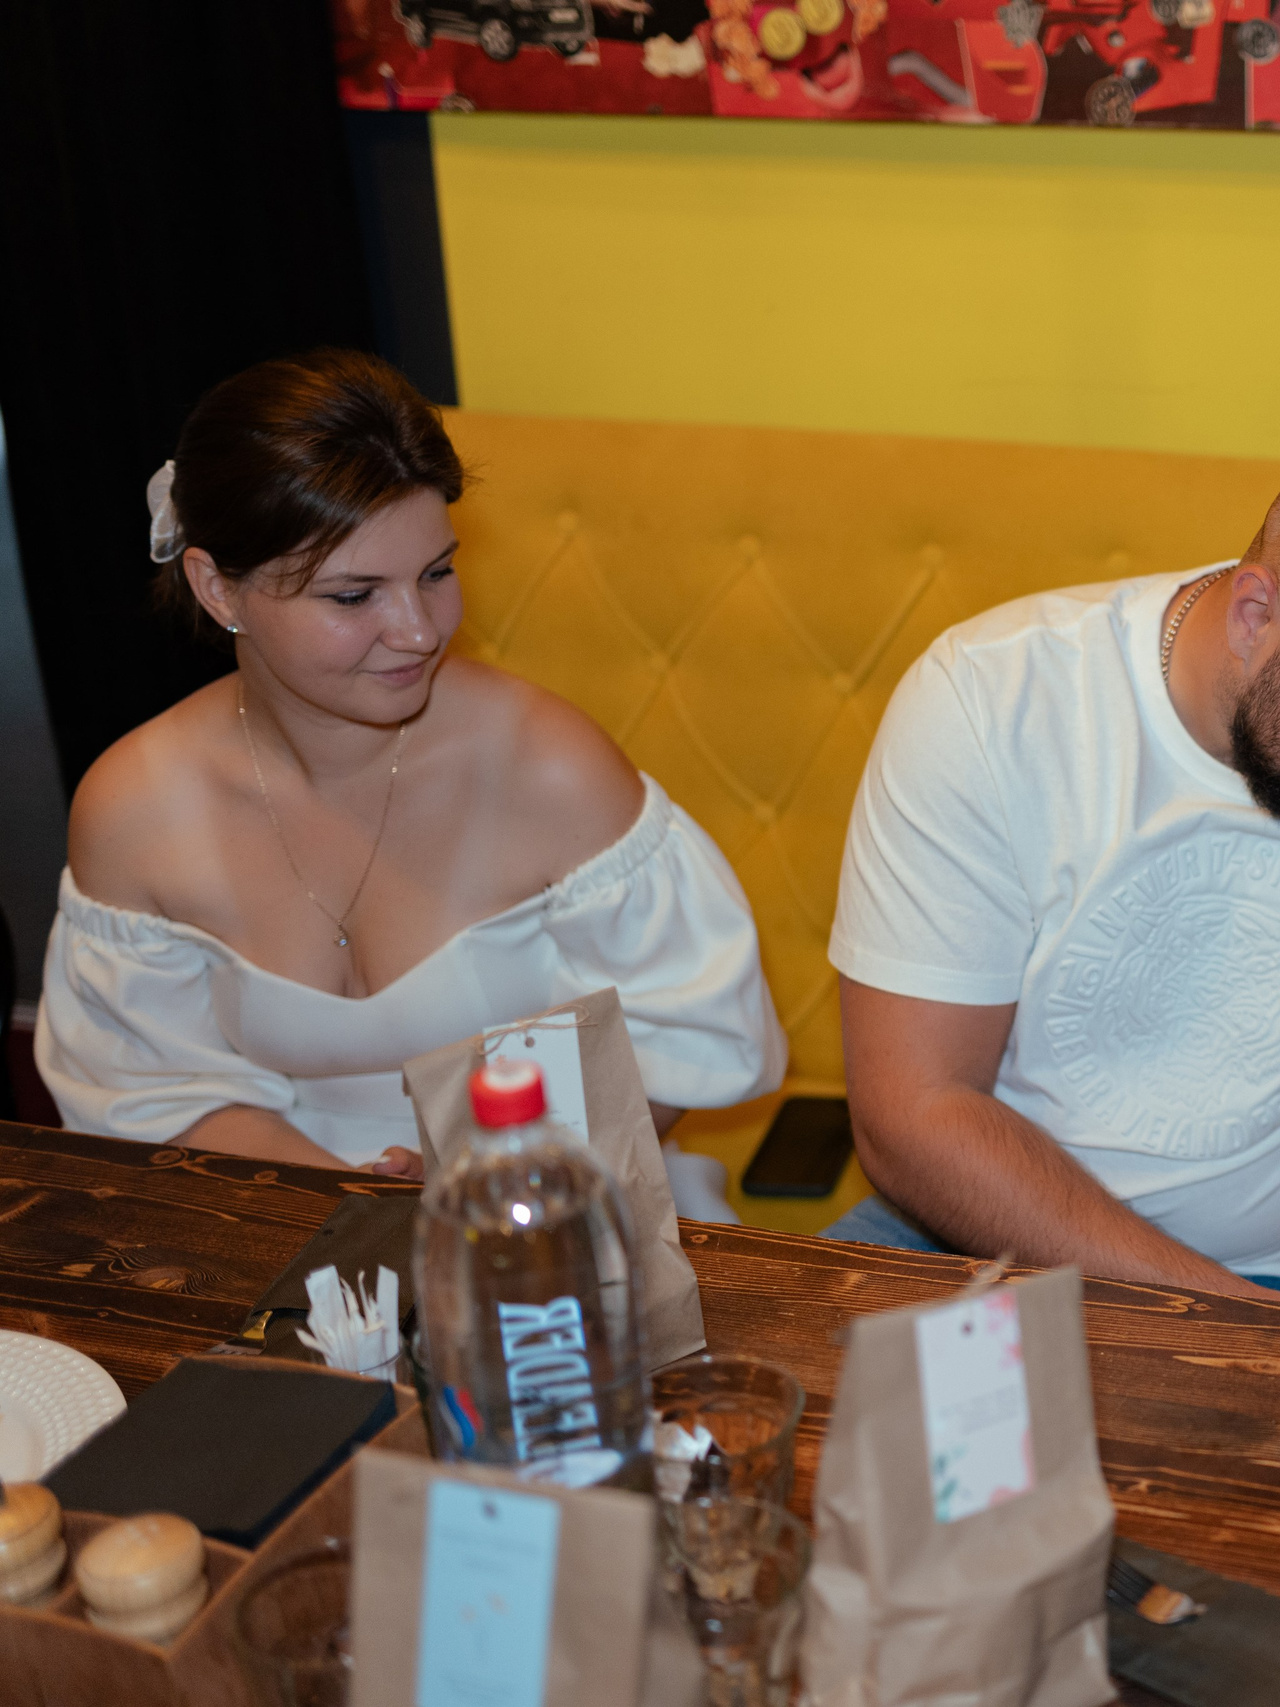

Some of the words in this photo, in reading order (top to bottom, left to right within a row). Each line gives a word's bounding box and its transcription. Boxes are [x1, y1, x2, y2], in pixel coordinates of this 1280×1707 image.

[1087, 842, 1202, 940] NEVER
[1058, 957, 1106, 1000] 19
[1045, 1013, 1095, 1059] BE
[1168, 1116, 1248, 1157] AND
